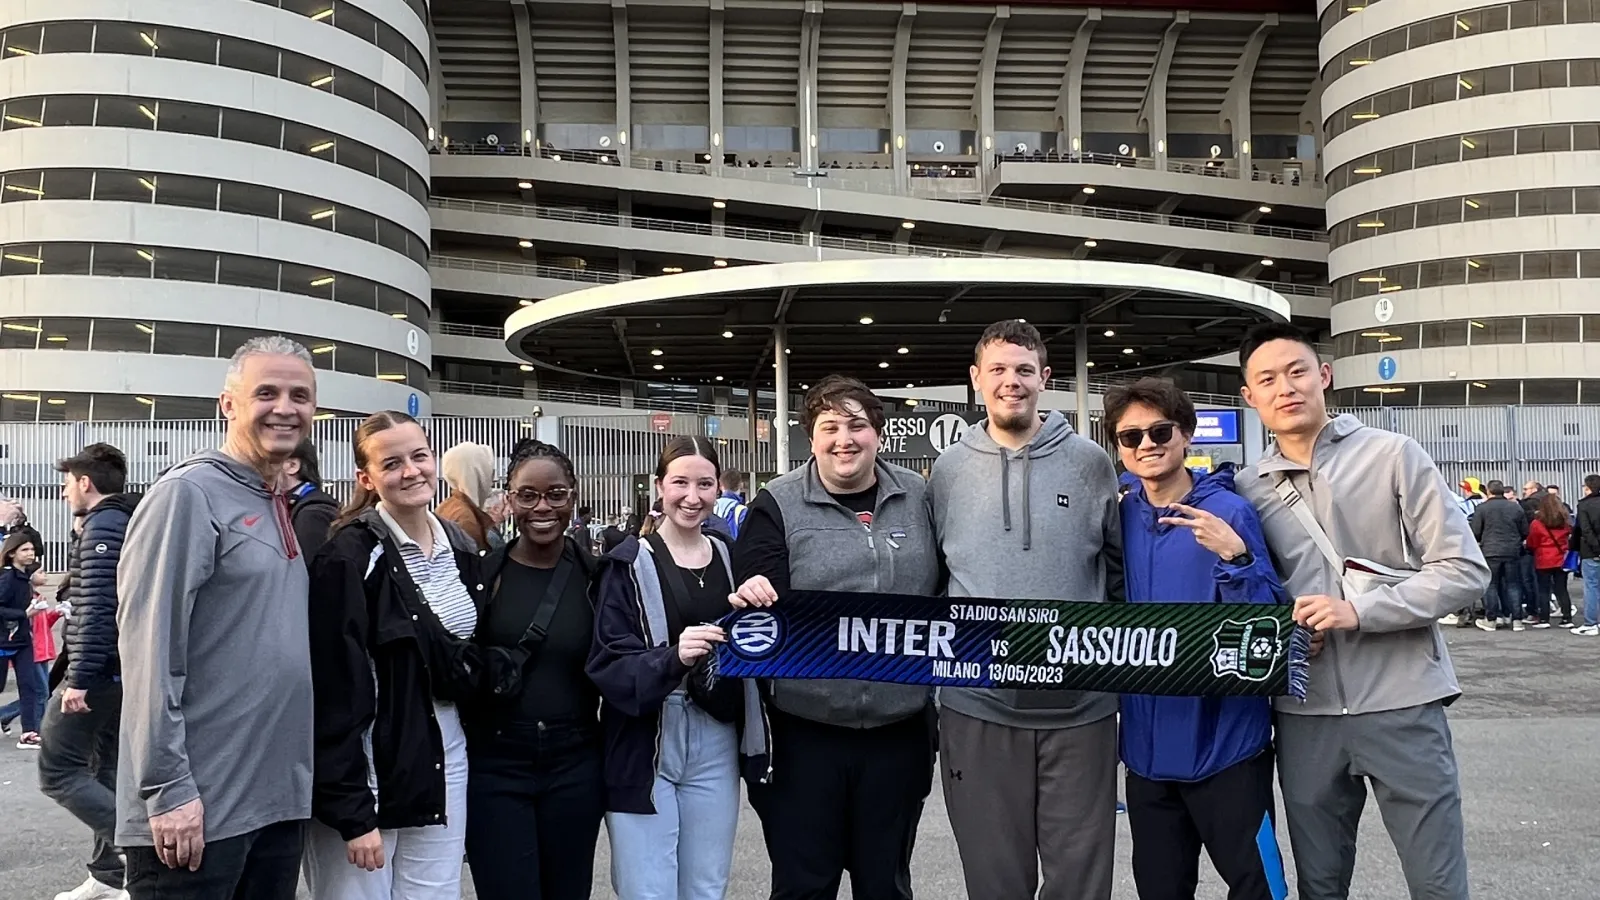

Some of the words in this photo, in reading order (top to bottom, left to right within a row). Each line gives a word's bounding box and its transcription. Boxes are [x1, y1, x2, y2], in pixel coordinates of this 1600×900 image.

[935, 419, 962, 450] 14
[950, 604, 998, 621] STADIO
[999, 606, 1026, 623] SAN
[1028, 607, 1060, 624] SIRO
[837, 616, 956, 659] INTER
[1046, 625, 1178, 667] SASSUOLO
[932, 659, 981, 680] MILANO
[987, 663, 1064, 684] 13/05/2023
